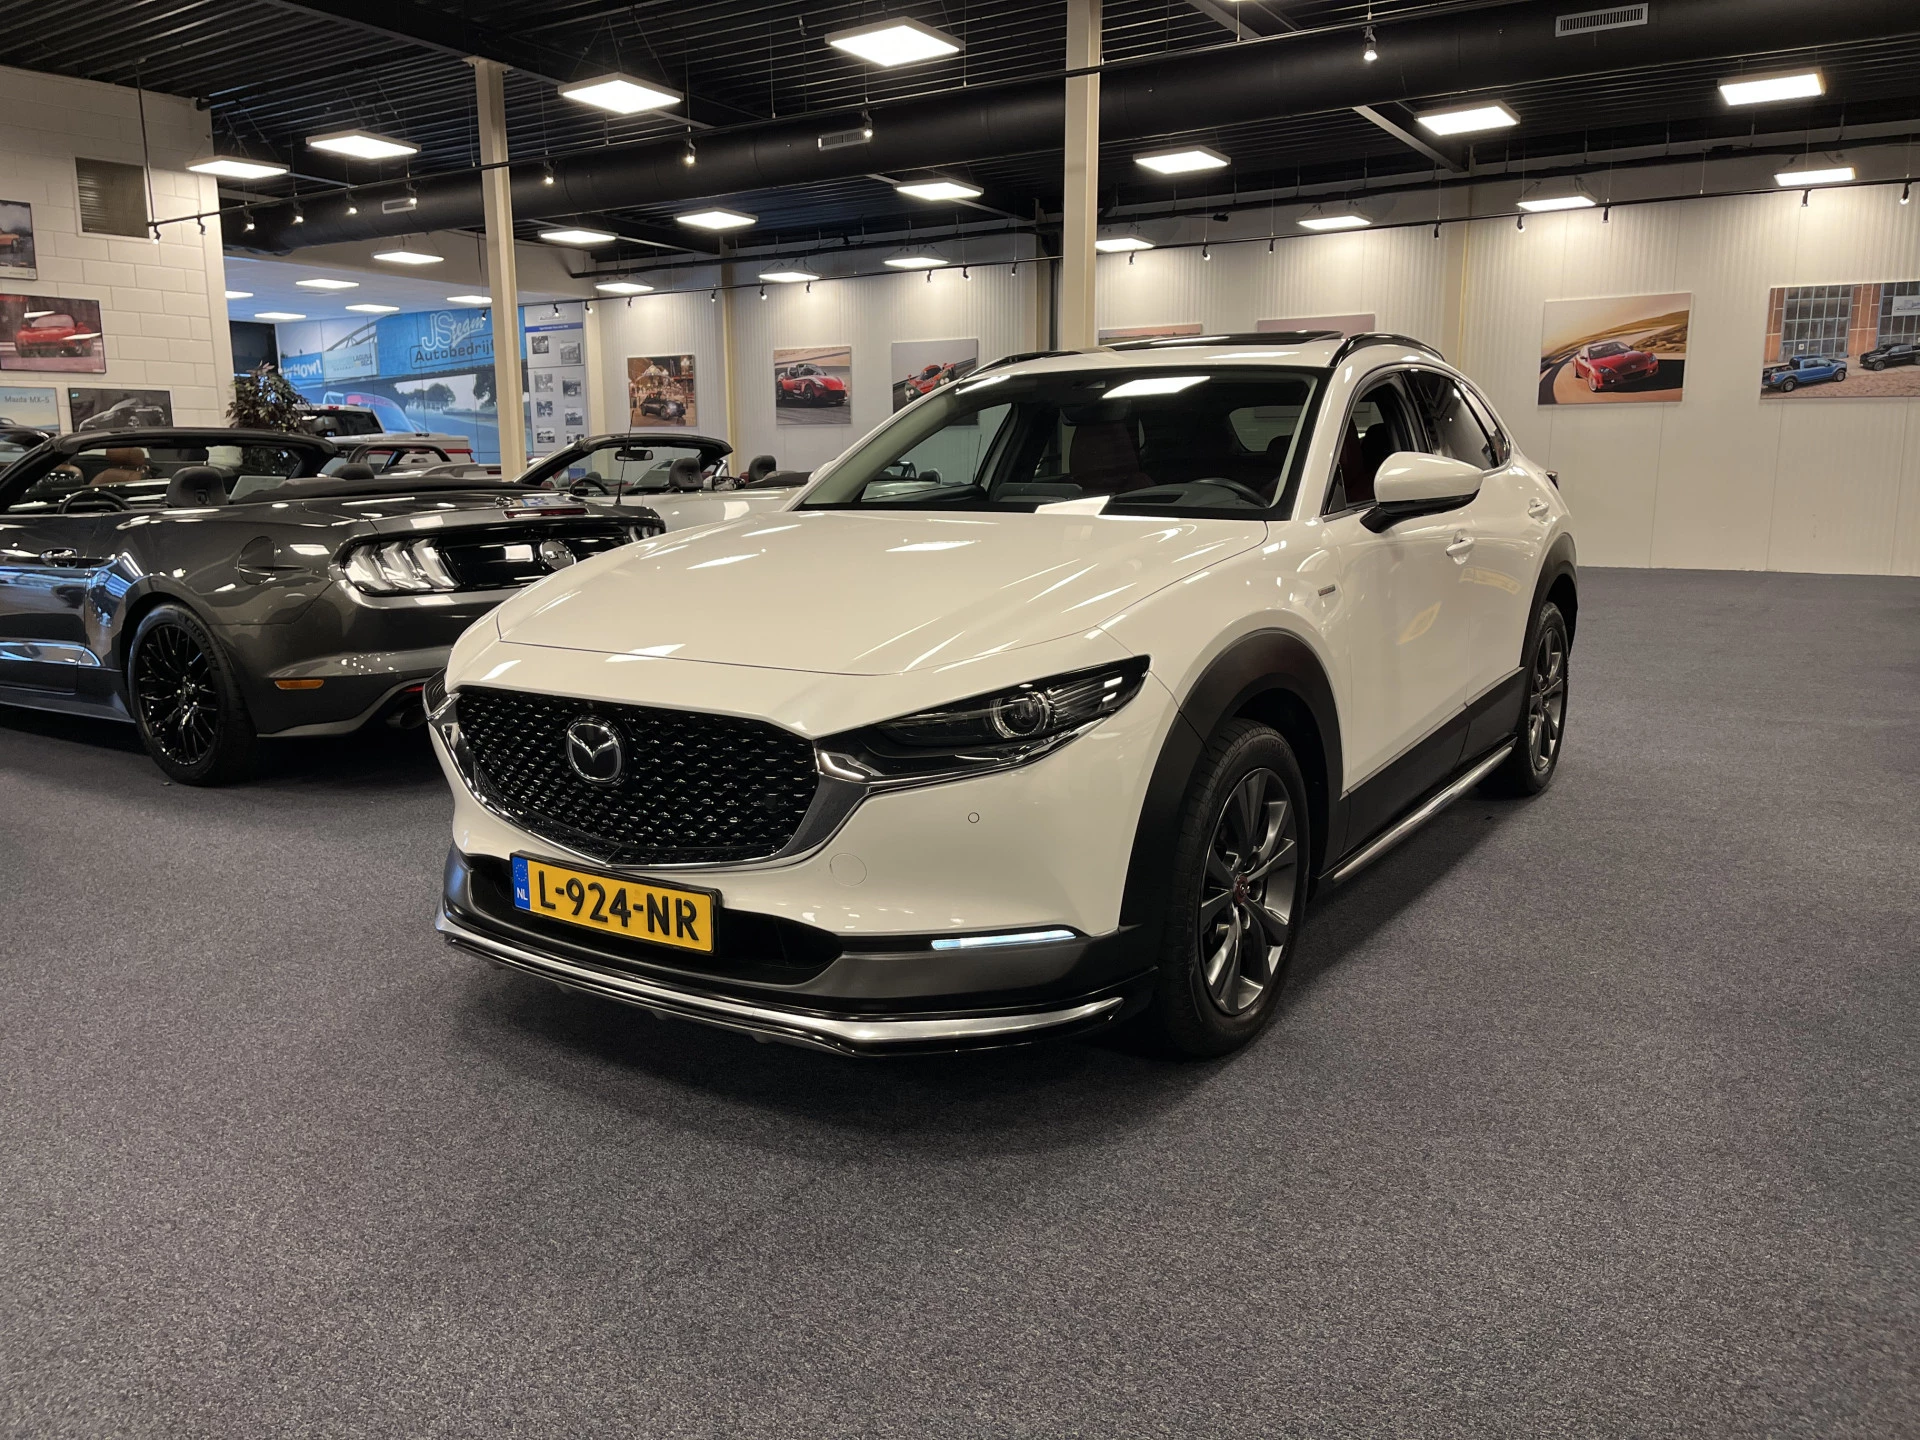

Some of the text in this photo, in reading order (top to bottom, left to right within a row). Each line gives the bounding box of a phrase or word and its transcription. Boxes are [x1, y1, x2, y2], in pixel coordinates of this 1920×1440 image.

[5, 395, 27, 403] Mazda
[516, 888, 528, 901] NL
[538, 870, 699, 941] L-924-NR
